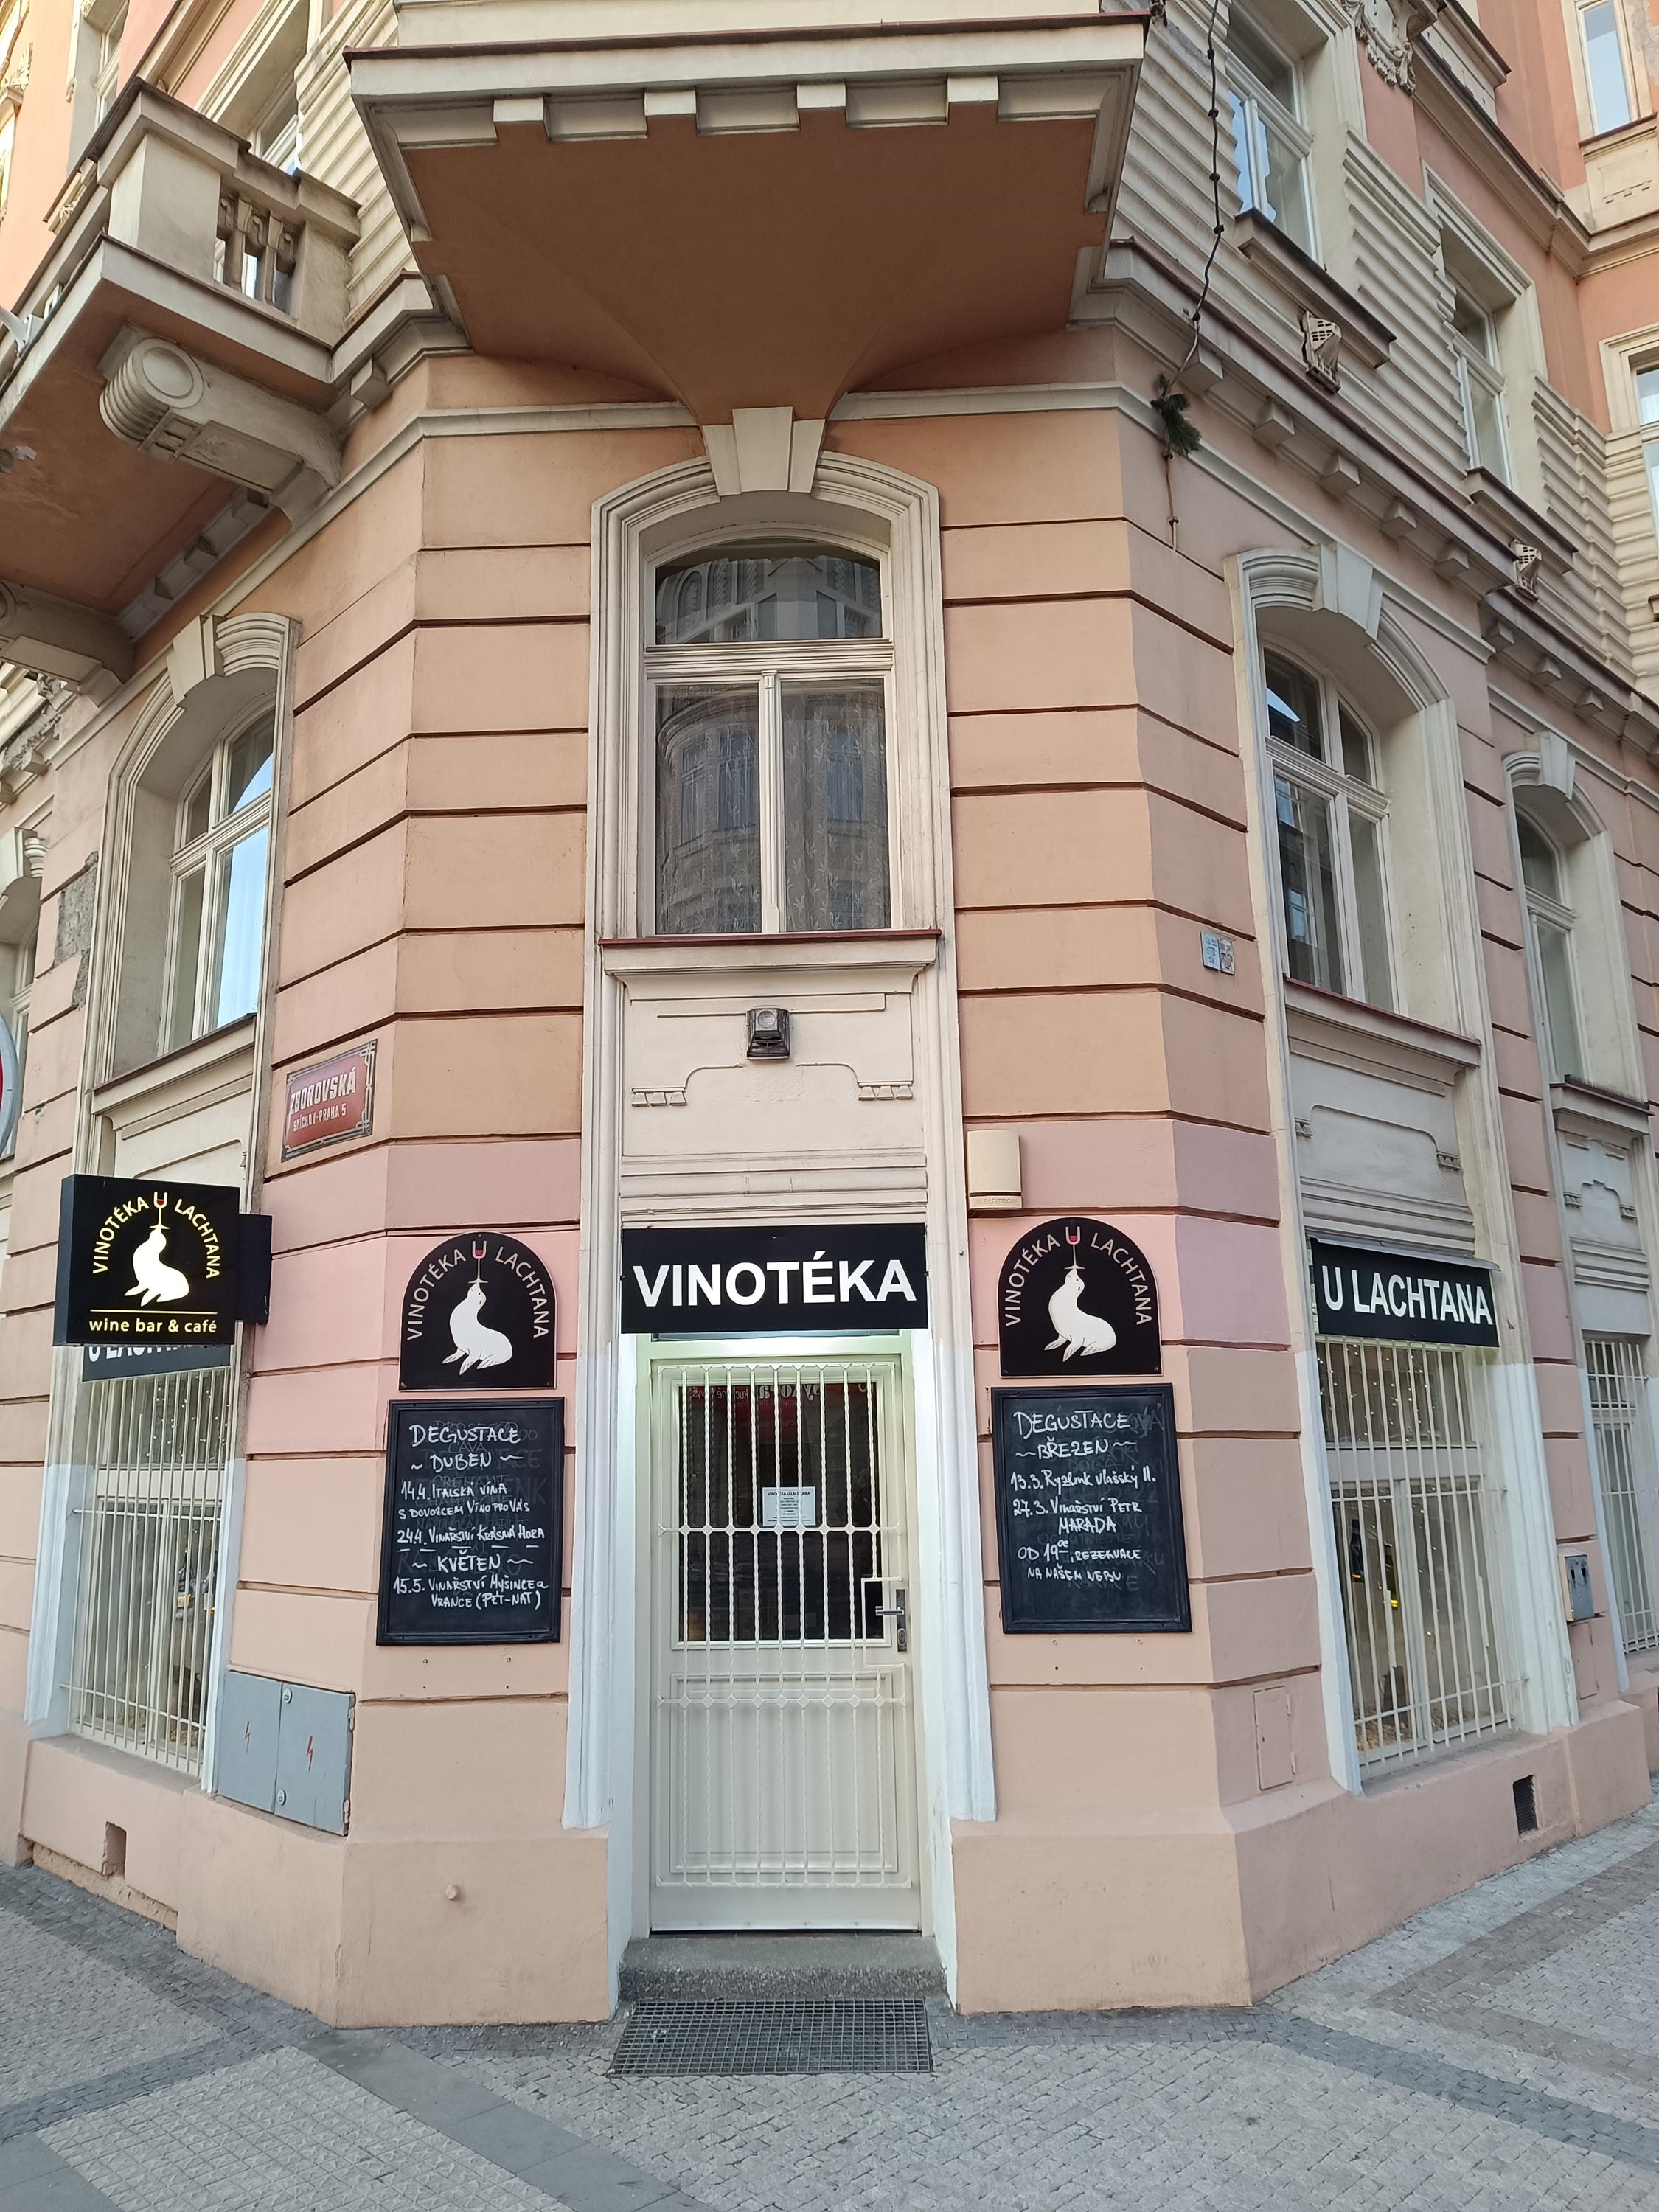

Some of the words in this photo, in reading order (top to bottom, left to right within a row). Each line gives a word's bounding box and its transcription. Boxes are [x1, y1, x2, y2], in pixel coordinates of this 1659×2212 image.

[290, 1066, 356, 1116] ZBOROVSKÁ
[341, 1103, 347, 1116] 5
[92, 1197, 150, 1274] VINOTÉKA
[174, 1198, 220, 1279] LACHTANA
[632, 1250, 917, 1307] VINOTÉKA
[1005, 1234, 1061, 1327] VINOTÉKA
[1091, 1232, 1152, 1326] LACHTANA
[407, 1248, 467, 1341] VINOTÉKA
[495, 1246, 549, 1338] LACHTANA
[1321, 1265, 1343, 1310] U
[1352, 1269, 1493, 1325] LACHTANA
[88, 1318, 130, 1332] wine
[136, 1318, 163, 1332] bar
[167, 1319, 179, 1332] &
[184, 1320, 218, 1333] café
[1013, 1410, 1132, 1439] DEGUSTACE
[409, 1424, 522, 1447] DEGUSTACE
[1037, 1436, 1109, 1460] BŘEZEN
[429, 1451, 492, 1473] DUBEN
[400, 1480, 431, 1500] 14.4.
[1010, 1471, 1044, 1492] 13.3.
[398, 1509, 407, 1520] S
[466, 1499, 491, 1514] VÍNO
[1012, 1498, 1049, 1517] 27.3.
[1107, 1497, 1143, 1513] PETR
[398, 1527, 428, 1545] 24.4.
[428, 1526, 476, 1543] VINAŘSTVÍ
[476, 1524, 516, 1542] KRÁSNÁ
[1058, 1516, 1117, 1536] MARADA
[437, 1549, 501, 1573] KVĚTEN
[1018, 1547, 1040, 1561] OD
[393, 1576, 425, 1595] 15.5.
[428, 1574, 488, 1593] VINAŘSTVÍ
[1027, 1567, 1043, 1581] NA
[431, 1593, 473, 1608] VRANCE
